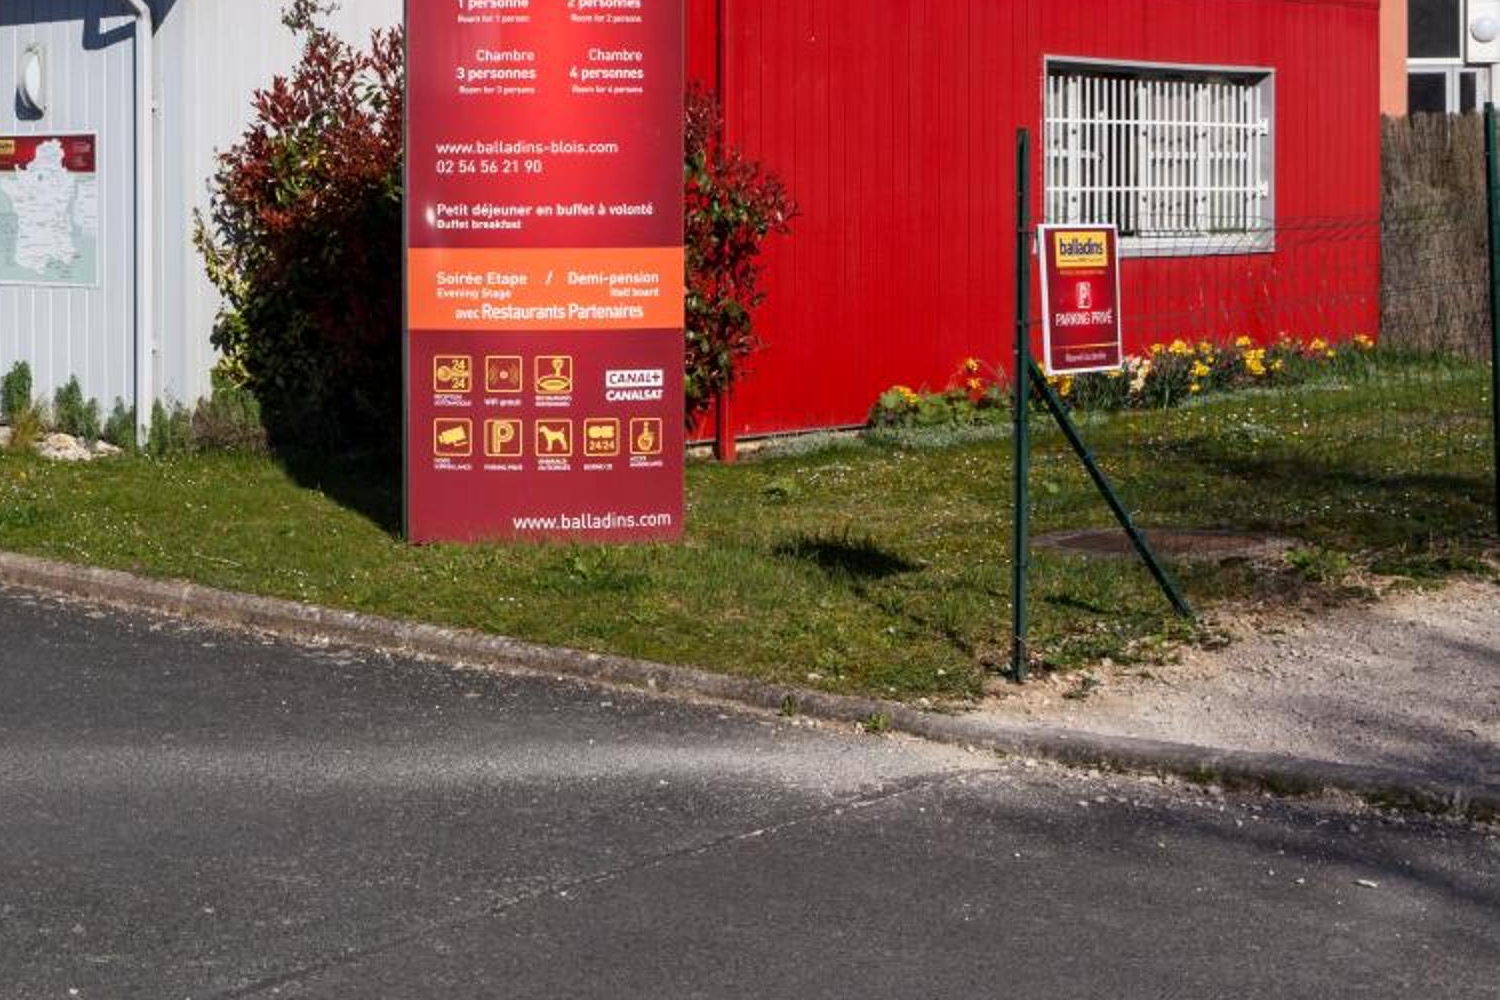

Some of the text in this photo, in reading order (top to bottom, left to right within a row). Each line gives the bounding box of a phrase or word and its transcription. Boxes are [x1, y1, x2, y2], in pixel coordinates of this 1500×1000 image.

[476, 49, 535, 62] Chambre
[588, 49, 643, 62] Chambre
[456, 67, 536, 82] 3 personnes
[569, 67, 644, 81] 4 personnes
[436, 141, 618, 154] www.balladins-blois.com
[436, 159, 542, 173] 02 54 56 21 90
[437, 202, 654, 219] Petit déjeuner en buffet à volonté
[437, 219, 522, 229] Buffet breakfast
[1060, 238, 1103, 255] balladins
[436, 272, 482, 285] Soirée
[487, 272, 528, 287] Etape
[568, 270, 659, 285] Demi-pension
[437, 288, 512, 300] Evening Stage
[456, 302, 644, 320] avec Restaurants Partenaires
[1055, 312, 1092, 327] PARKING
[451, 359, 466, 371] 24
[451, 378, 465, 389] 24
[609, 373, 661, 385] CANAL+
[605, 389, 663, 401] CANALSAT
[513, 512, 671, 530] www.balladins.com
